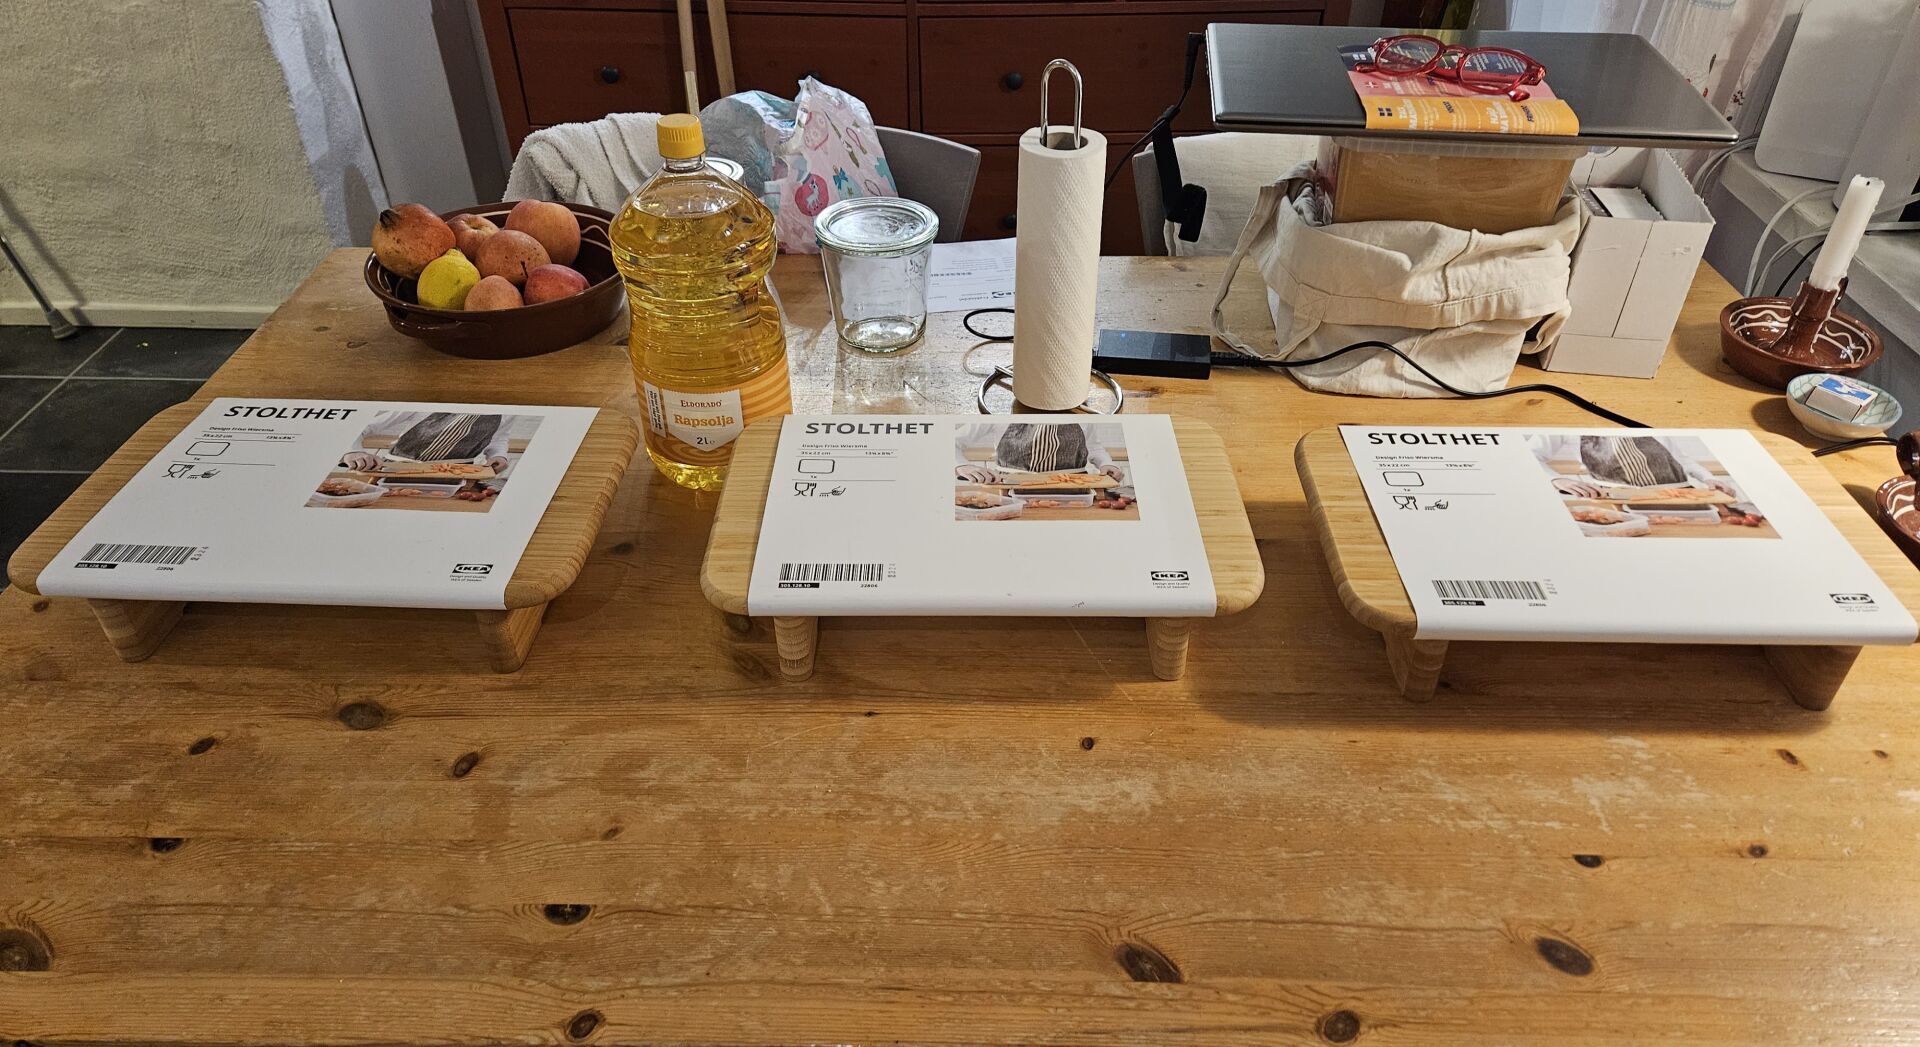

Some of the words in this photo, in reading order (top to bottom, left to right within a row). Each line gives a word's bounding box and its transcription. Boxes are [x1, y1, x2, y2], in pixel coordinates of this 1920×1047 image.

[681, 399, 722, 408] ELDORADO
[224, 406, 357, 420] STOLTHET
[673, 414, 734, 428] Rapsolja
[805, 422, 934, 434] STOLTHET
[1368, 433, 1500, 445] STOLTHET
